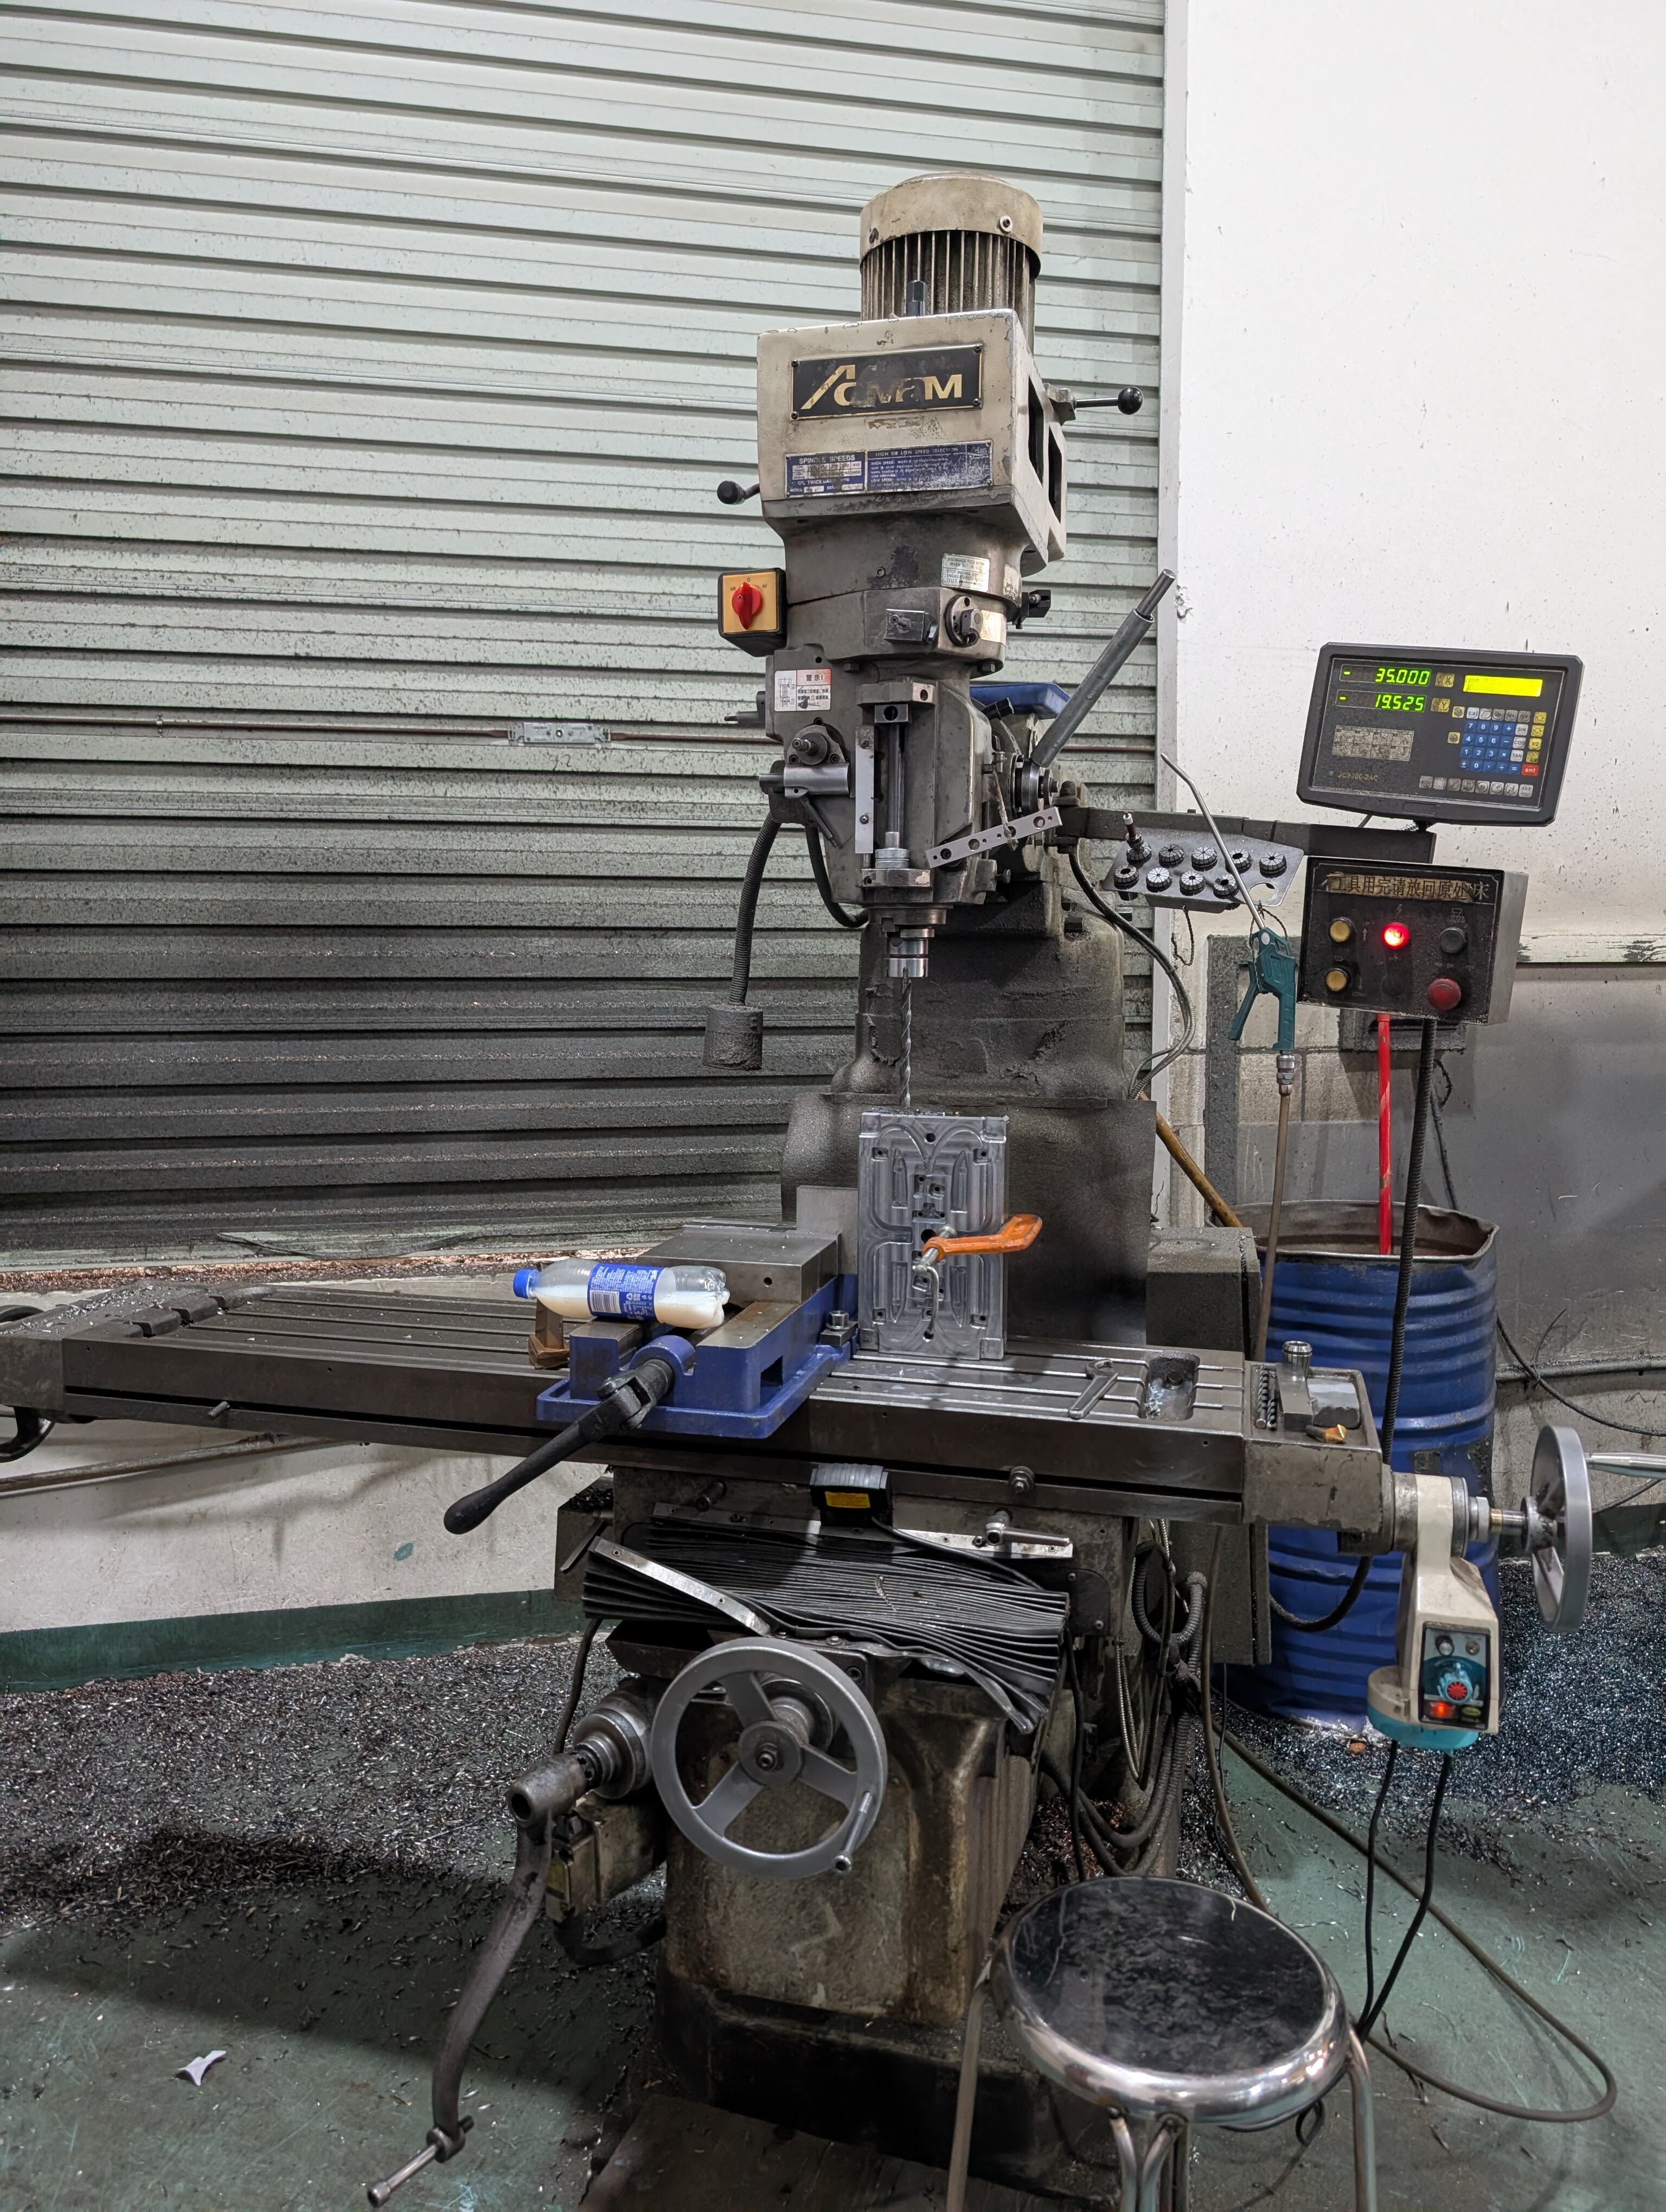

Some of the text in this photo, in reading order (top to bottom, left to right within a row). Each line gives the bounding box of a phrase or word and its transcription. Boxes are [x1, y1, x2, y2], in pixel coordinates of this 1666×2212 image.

[1375, 668, 1430, 685] 35.000
[1375, 694, 1424, 711] 19.525
[1333, 874, 1467, 900] 工具用完请放回原处
